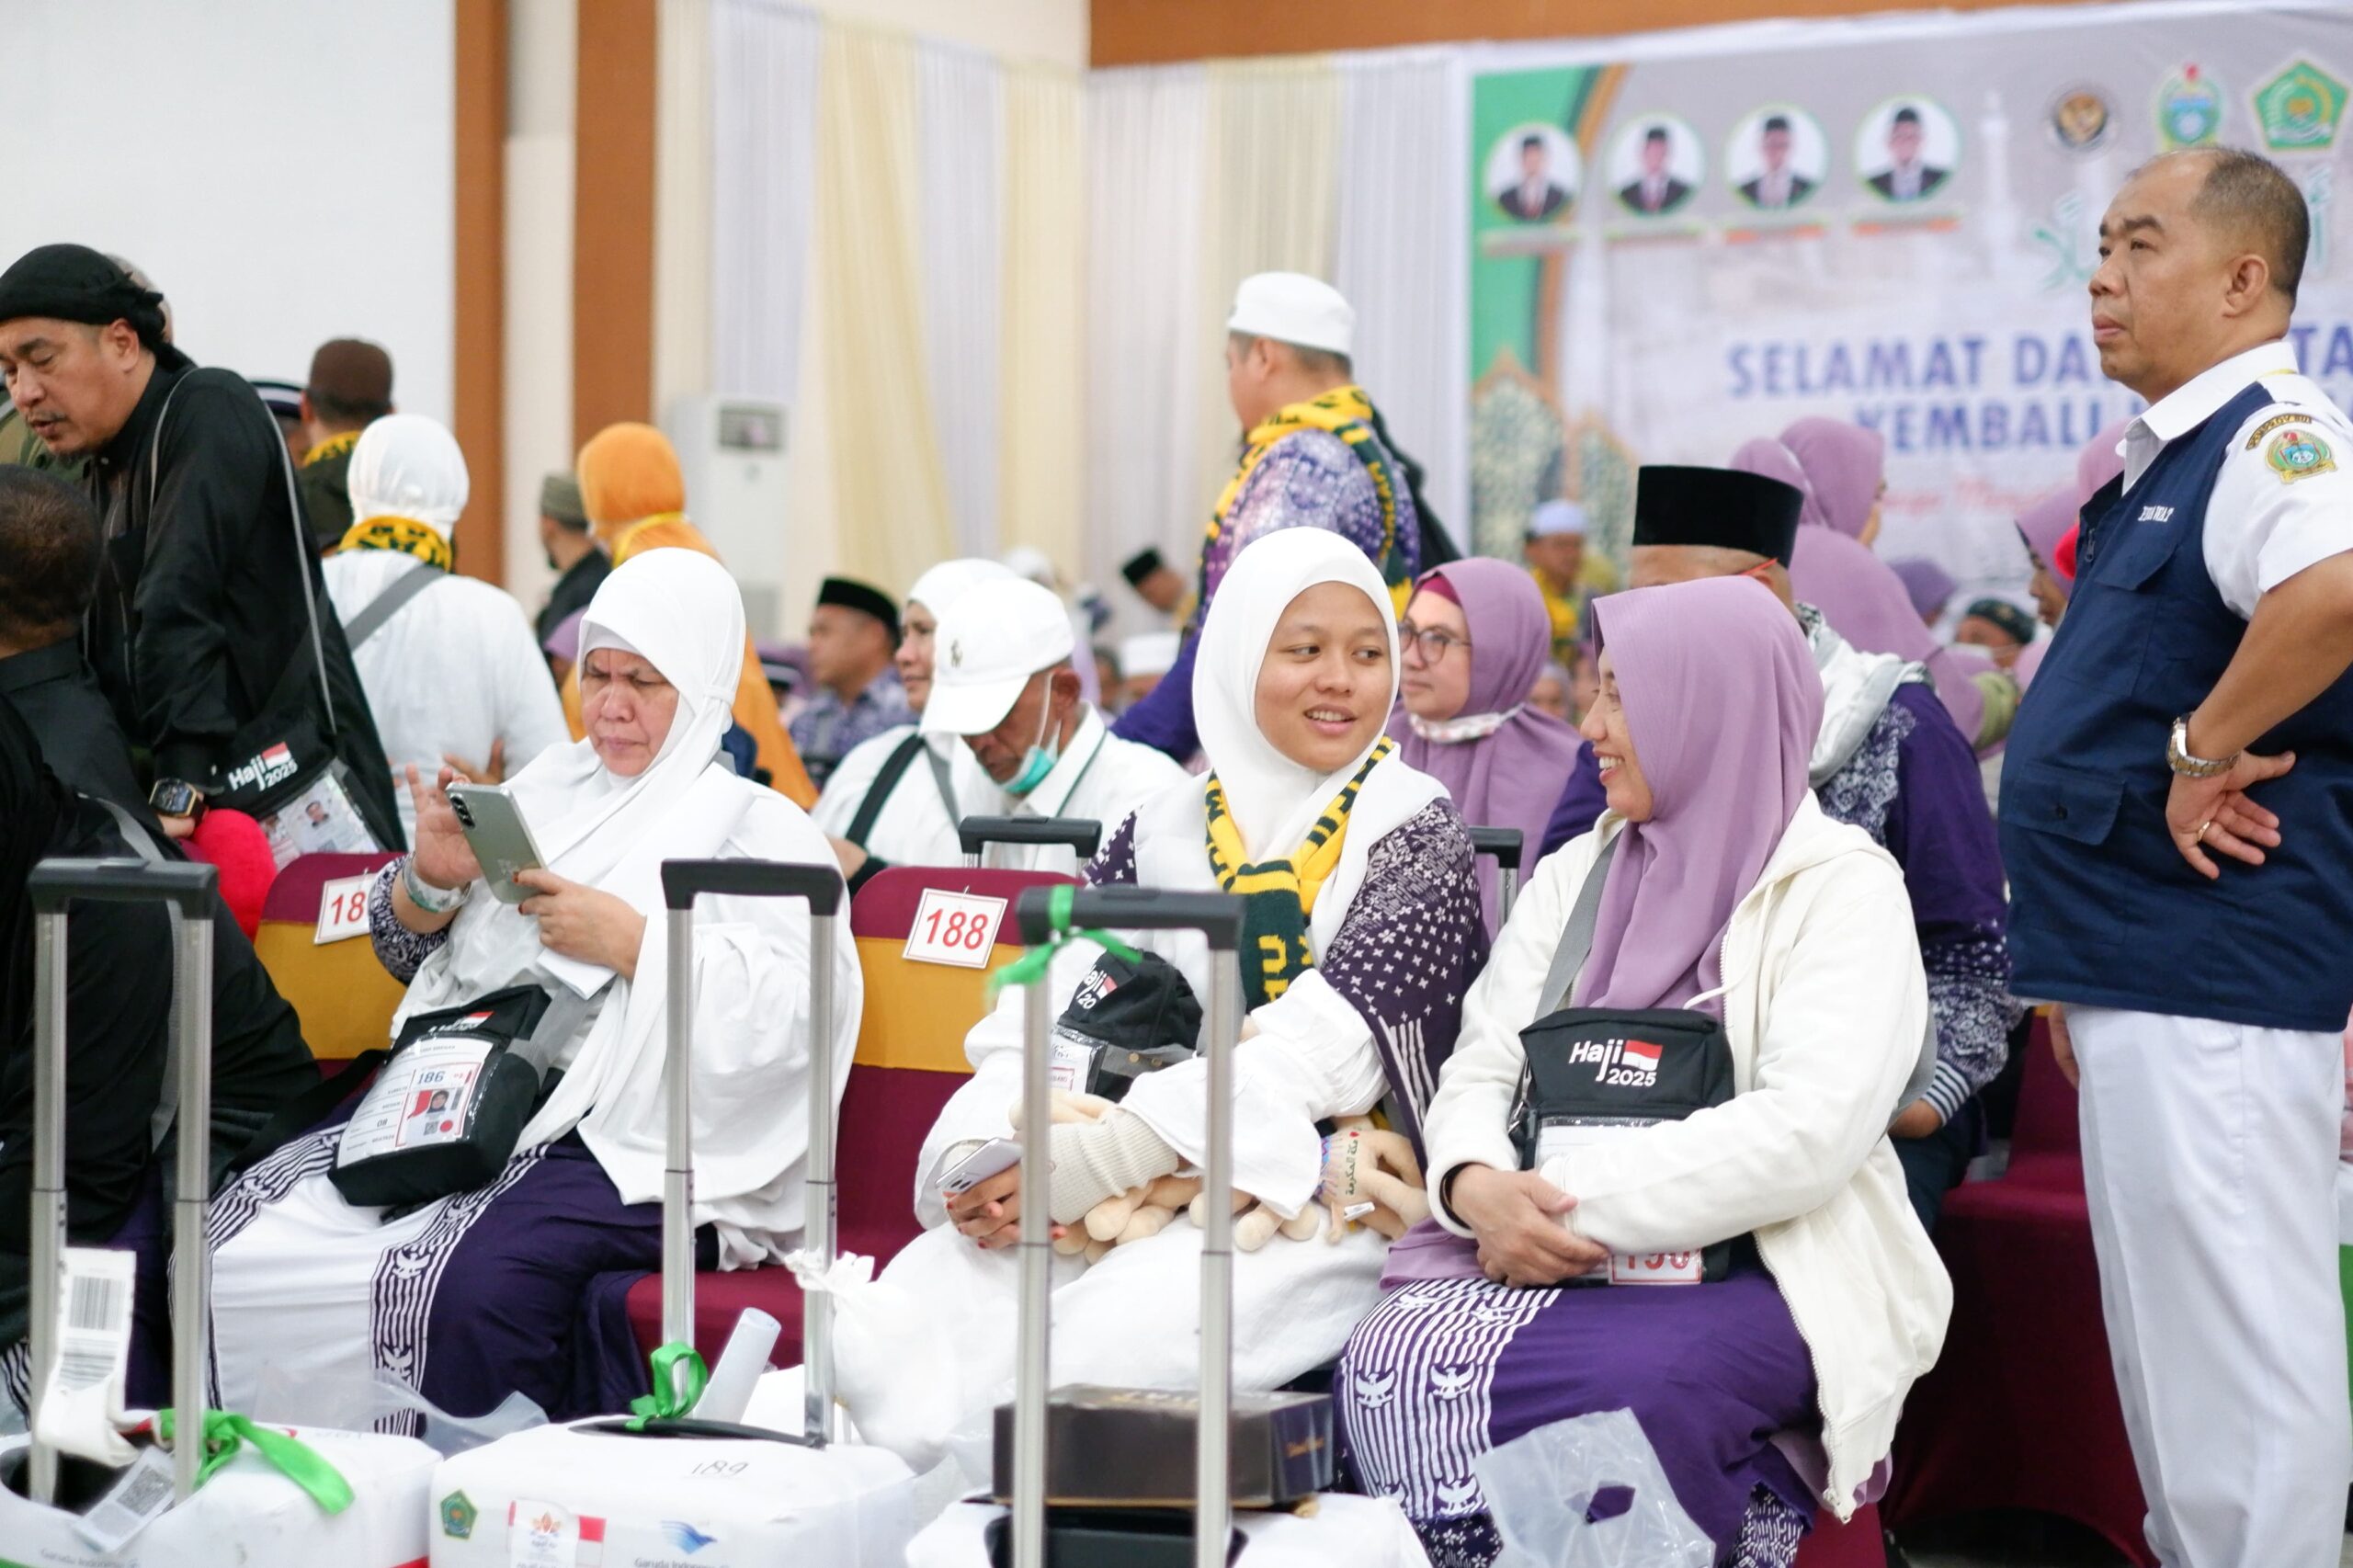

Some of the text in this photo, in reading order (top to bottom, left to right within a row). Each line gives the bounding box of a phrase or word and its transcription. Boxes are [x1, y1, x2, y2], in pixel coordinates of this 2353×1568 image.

[1728, 336, 1984, 398] SELAMAT
[229, 754, 267, 791] Haji
[265, 758, 299, 788] 2025
[331, 890, 368, 925] 18
[926, 908, 989, 950] 188
[1075, 964, 1108, 1000] aji
[416, 1070, 446, 1085] 186
[1568, 1039, 1624, 1082] Haji
[1607, 1068, 1657, 1087] 2025
